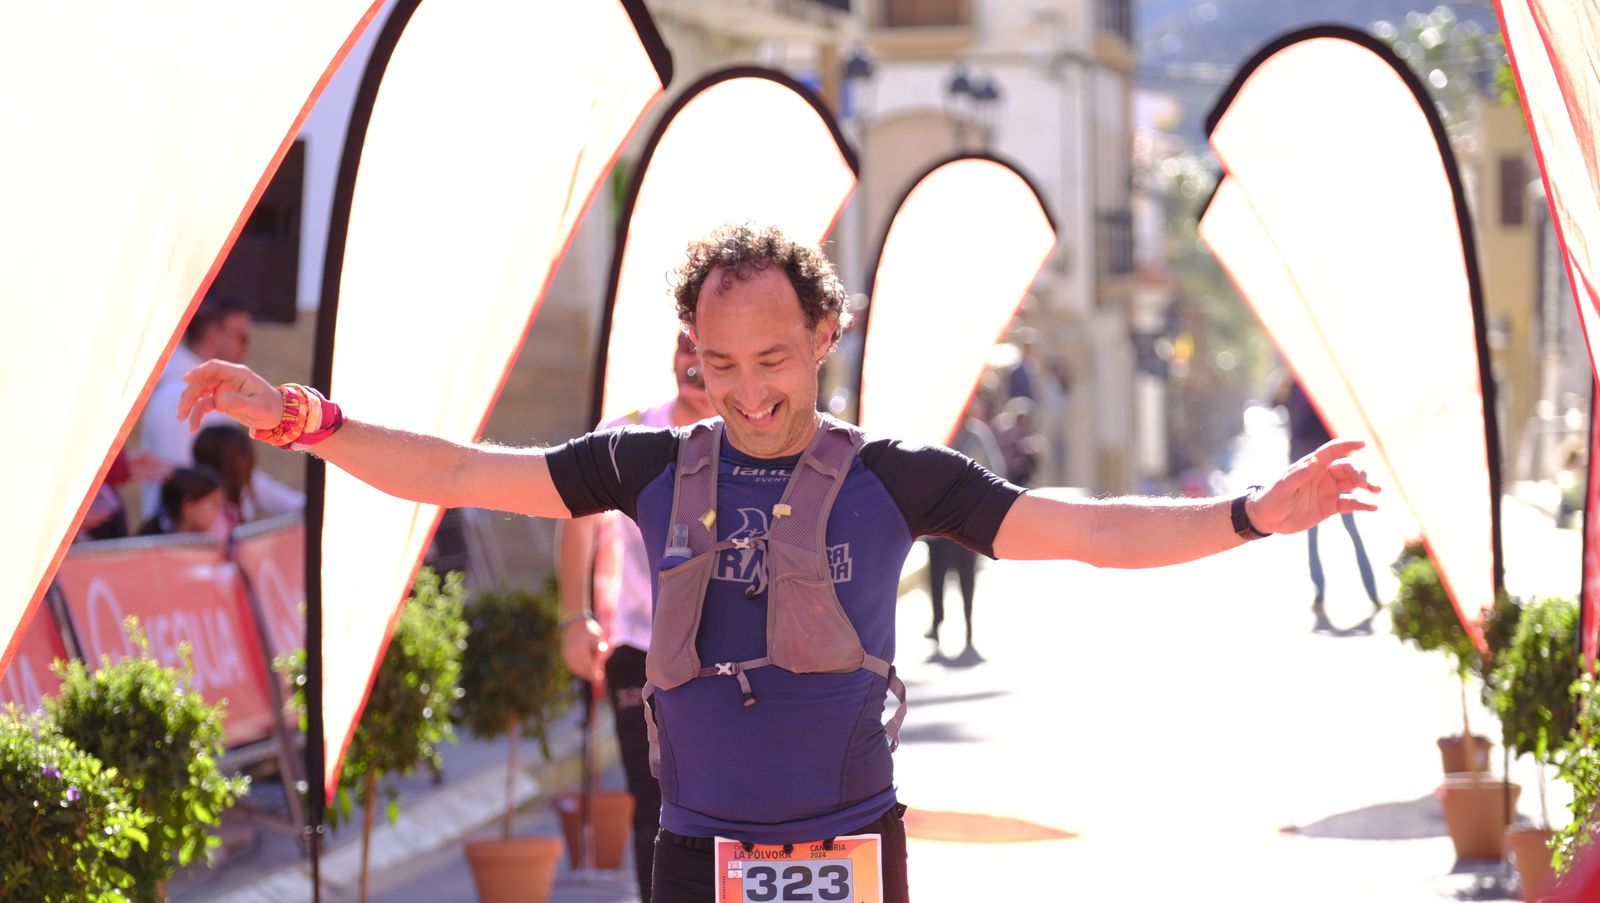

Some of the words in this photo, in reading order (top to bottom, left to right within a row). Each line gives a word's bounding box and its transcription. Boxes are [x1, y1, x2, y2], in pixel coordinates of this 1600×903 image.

[810, 843, 847, 852] CANRIA
[734, 850, 745, 860] LA
[748, 848, 792, 860] PÓLVORA
[747, 865, 849, 901] 323
